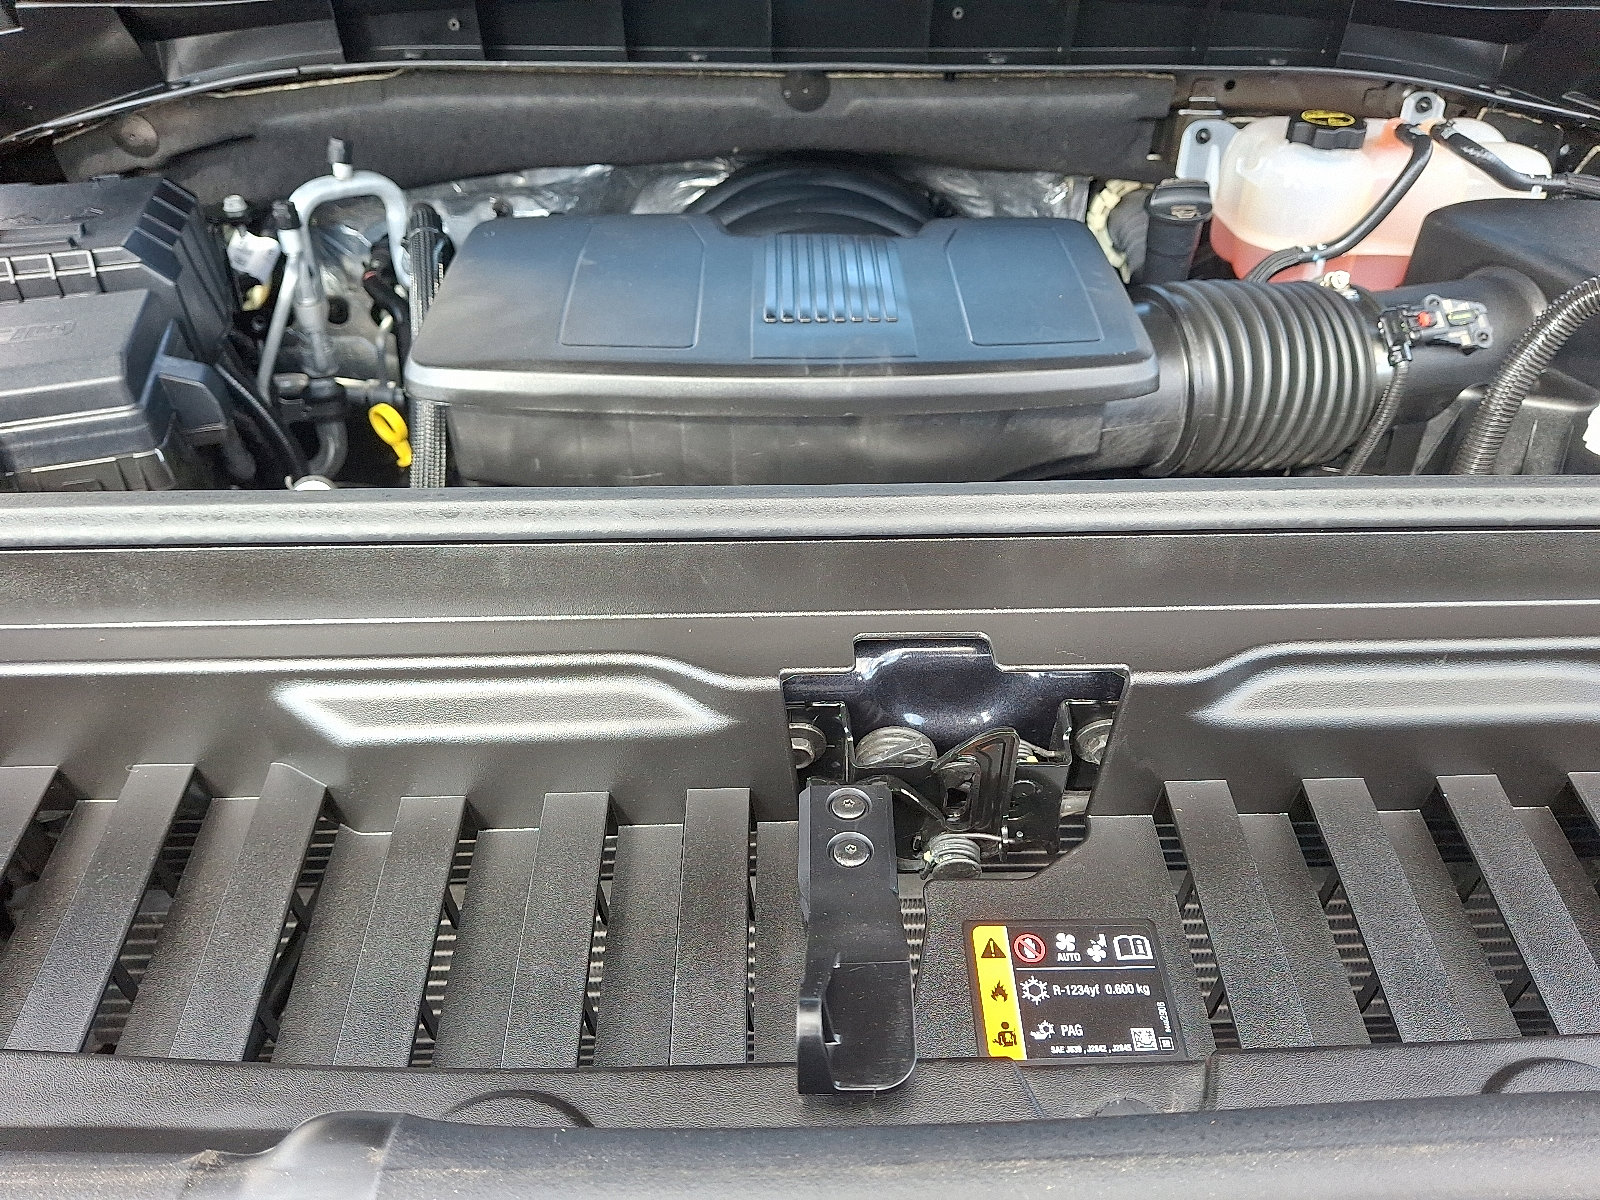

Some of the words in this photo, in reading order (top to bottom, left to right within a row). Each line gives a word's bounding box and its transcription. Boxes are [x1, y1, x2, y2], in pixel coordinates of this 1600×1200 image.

[1057, 952, 1081, 962] AUTO
[1104, 983, 1135, 995] 0.600
[1136, 983, 1151, 996] kg
[1060, 1024, 1084, 1037] PAG
[1050, 1045, 1065, 1054] SAE
